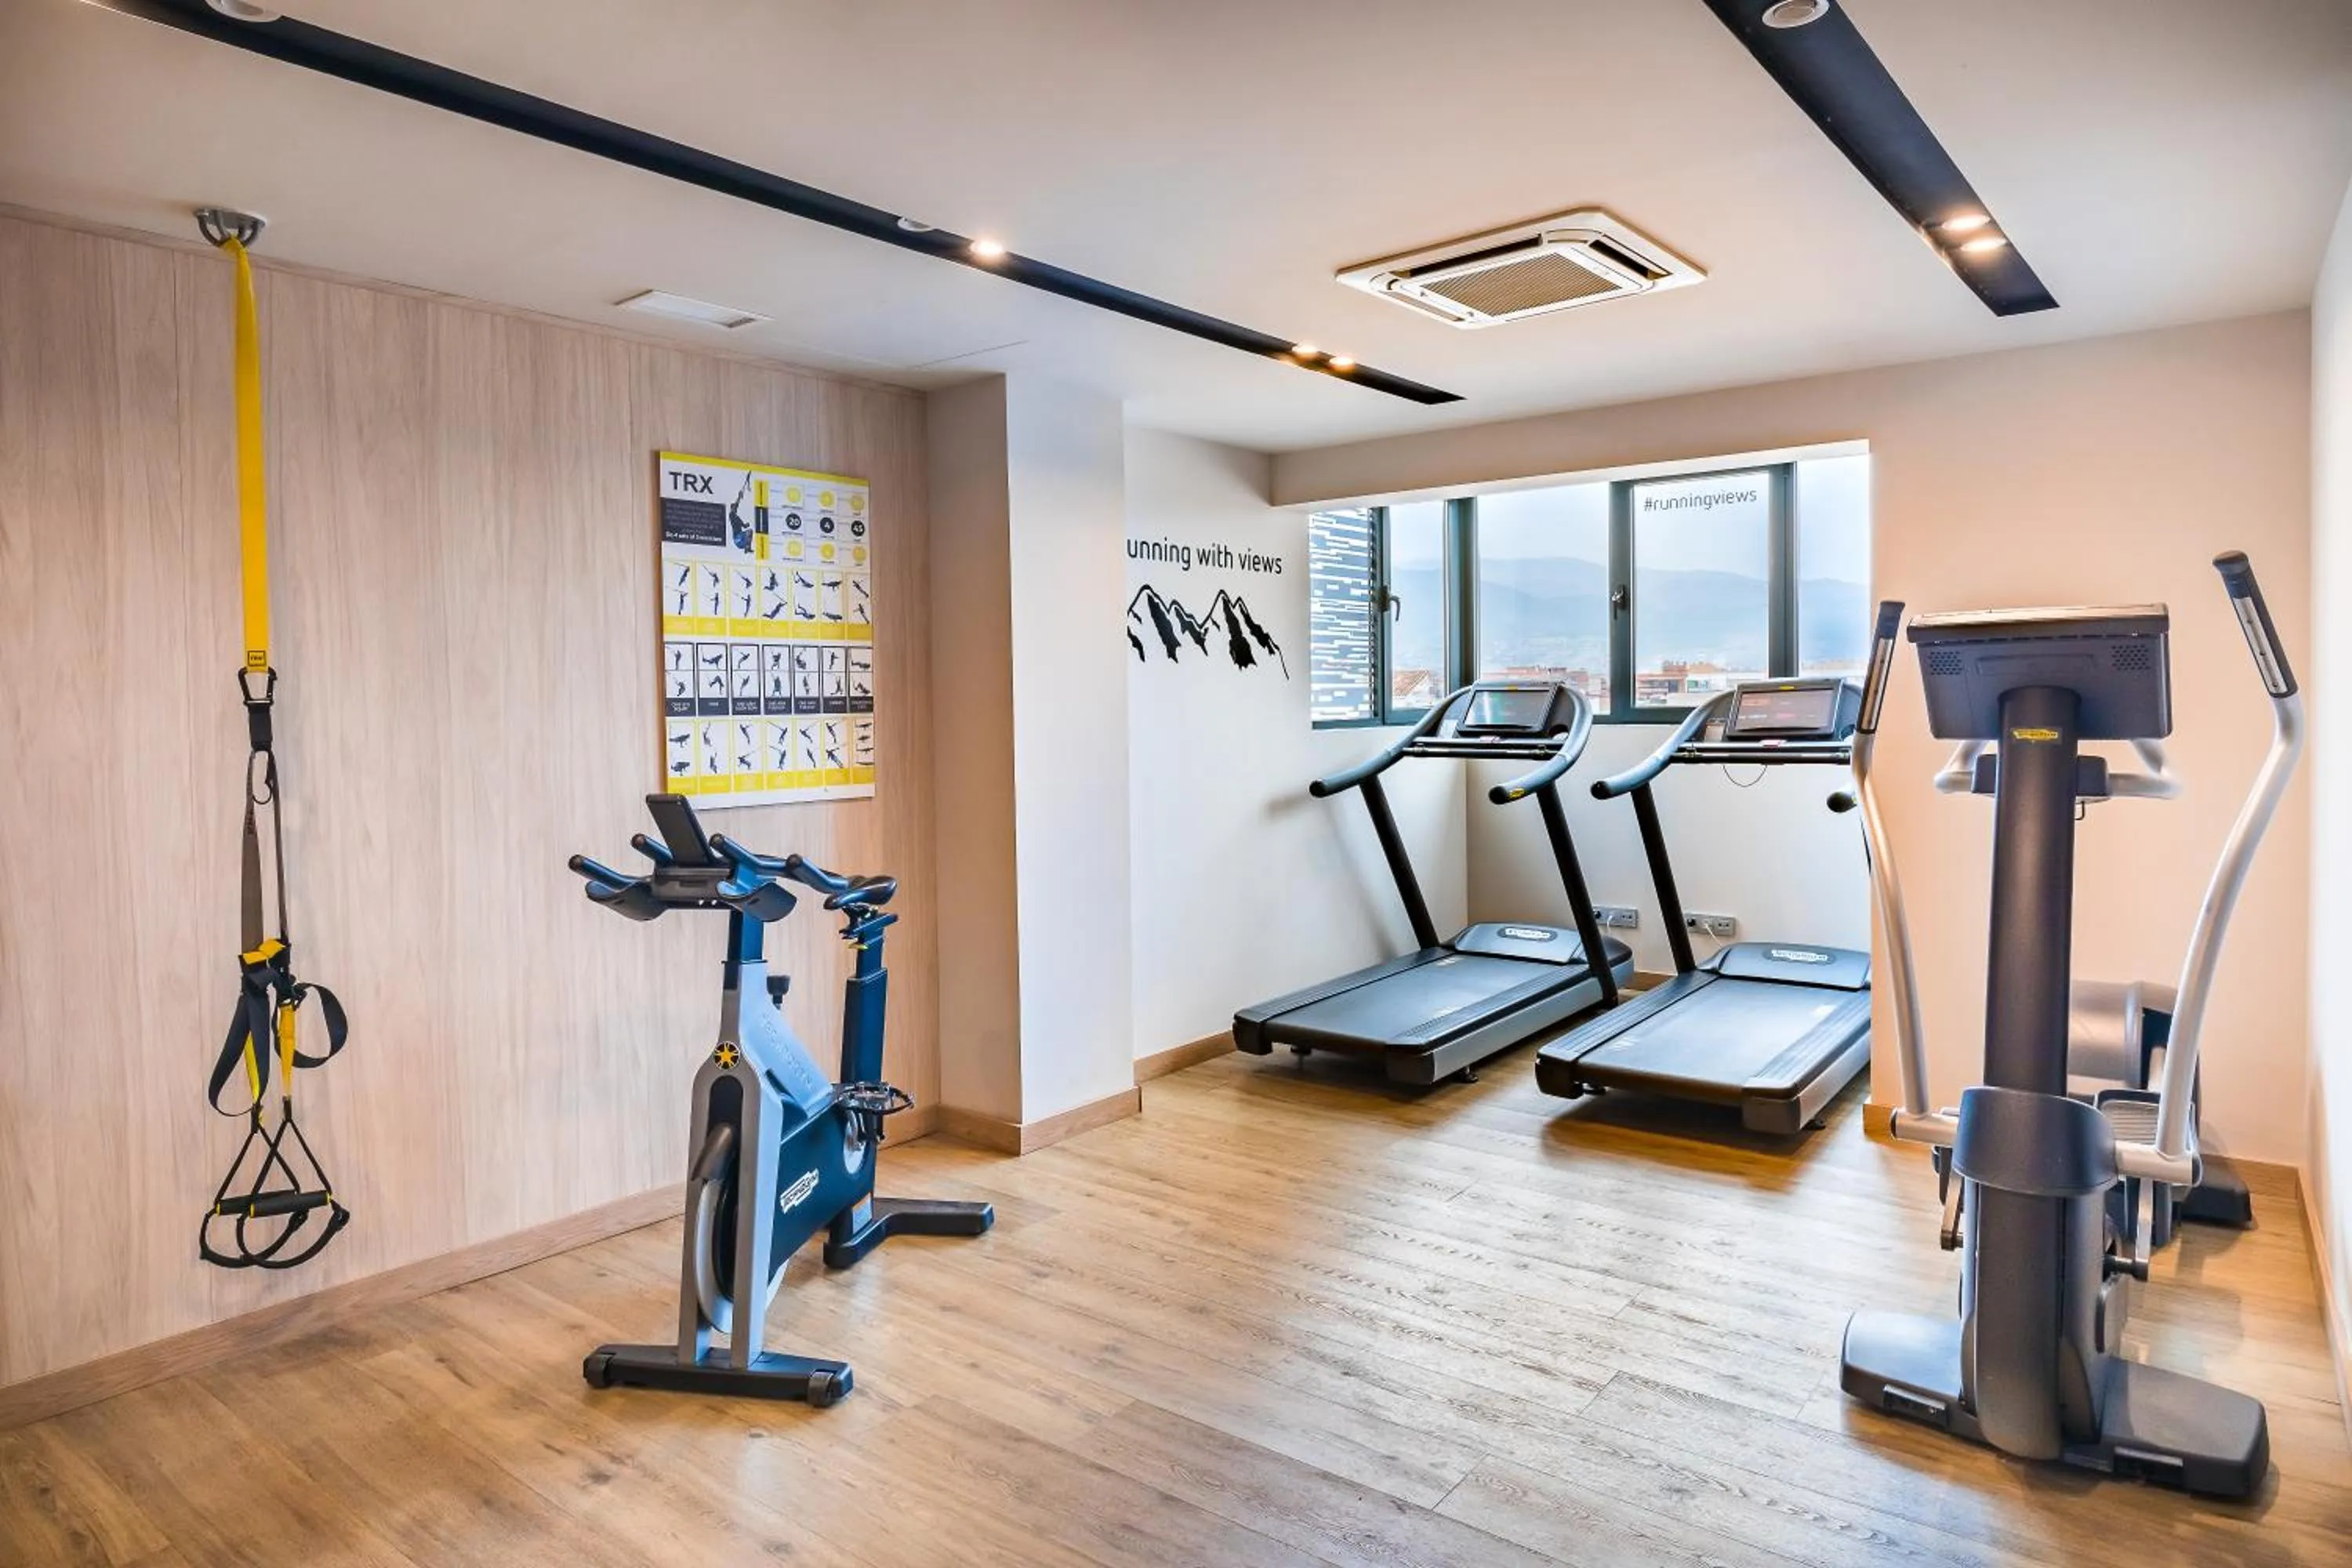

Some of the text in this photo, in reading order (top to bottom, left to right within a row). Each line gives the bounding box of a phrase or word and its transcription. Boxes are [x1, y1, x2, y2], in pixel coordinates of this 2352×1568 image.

[669, 471, 714, 495] TRX
[1643, 489, 1758, 511] #runningviews
[1127, 536, 1283, 575] unning with views
